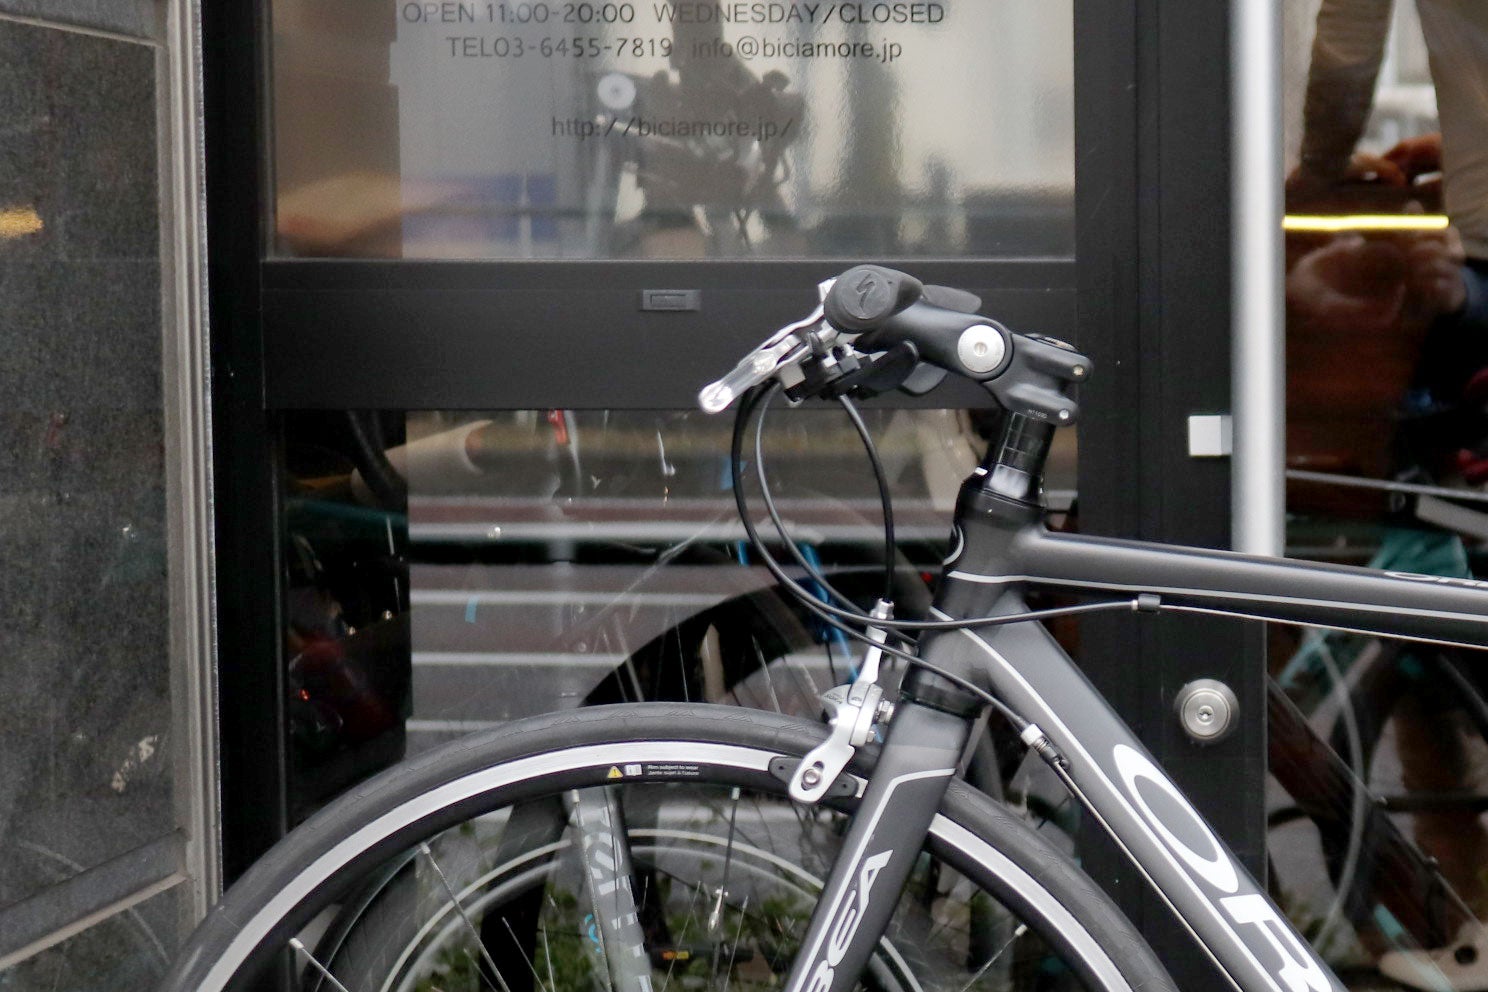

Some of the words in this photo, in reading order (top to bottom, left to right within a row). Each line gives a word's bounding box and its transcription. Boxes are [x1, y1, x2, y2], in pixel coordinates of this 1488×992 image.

[403, 3, 474, 23] OPEN
[487, 3, 635, 23] 11:00-20:00
[653, 3, 944, 24] WEDNESDAY/CLOSED
[446, 37, 673, 57] TEL03-6455-7819
[692, 36, 902, 62] info@biciamore.jp
[552, 117, 794, 141] http://biciamore.jp/
